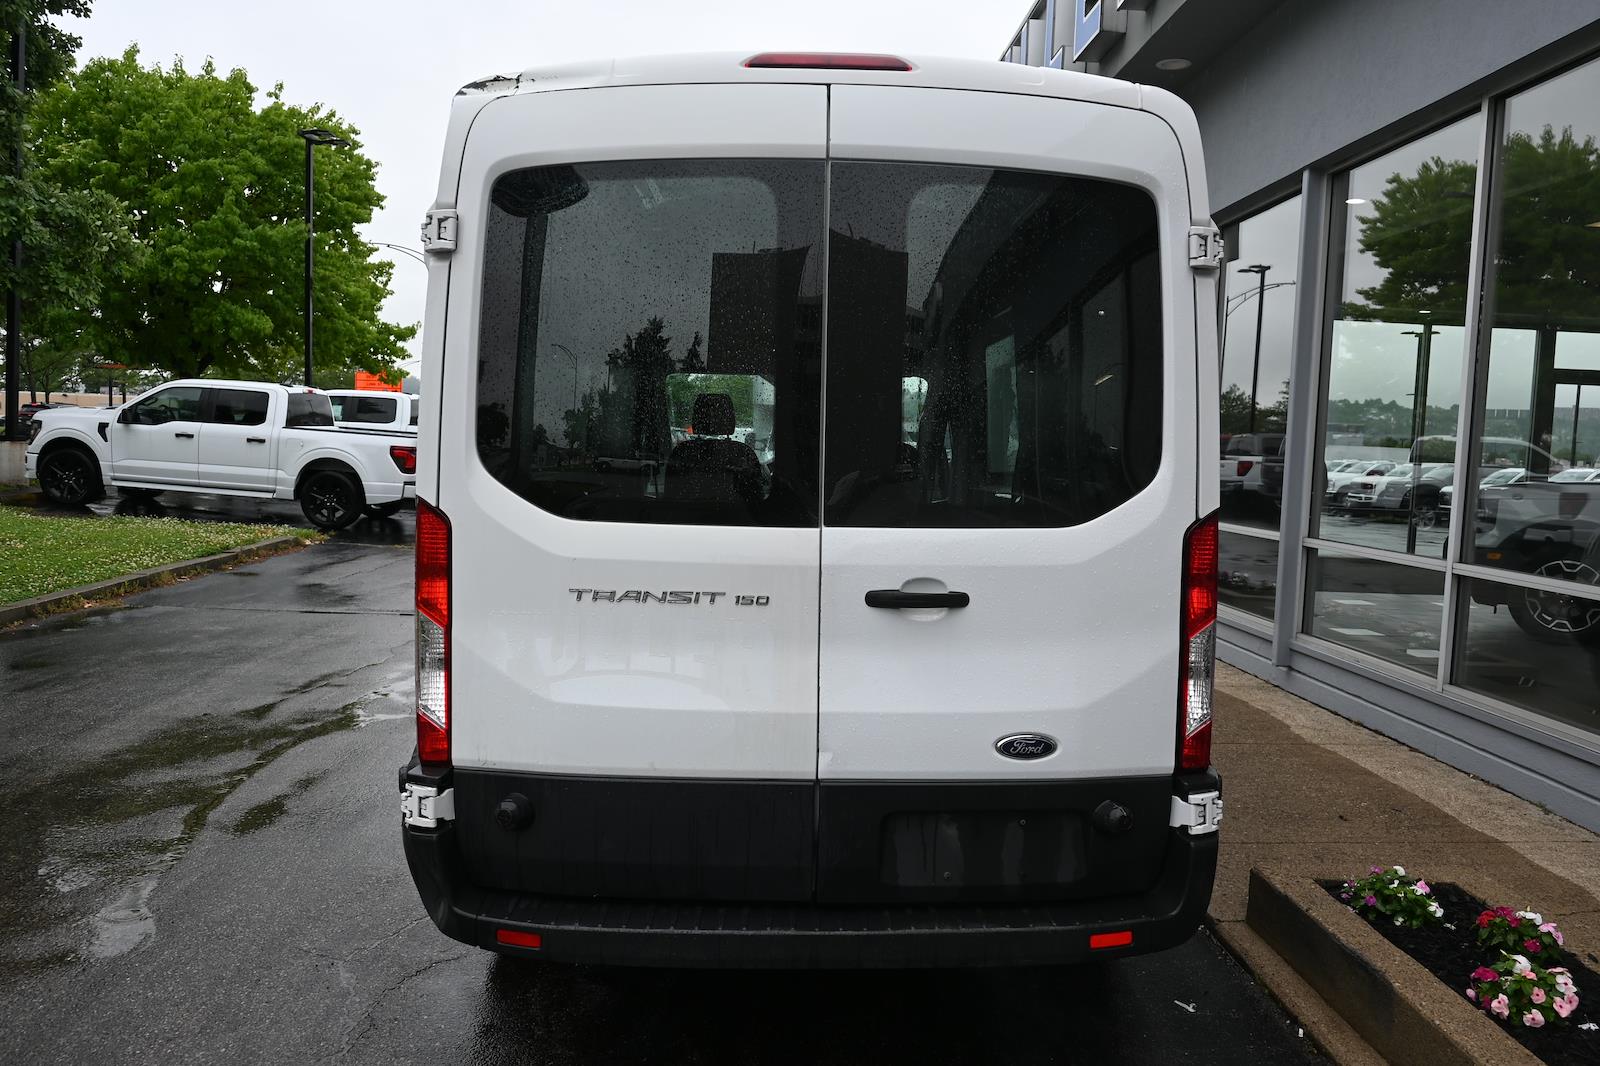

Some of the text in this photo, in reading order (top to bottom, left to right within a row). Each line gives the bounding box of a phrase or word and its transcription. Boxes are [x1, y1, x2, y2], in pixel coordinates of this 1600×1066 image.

[568, 588, 771, 607] TRANSIT 150
[1009, 739, 1045, 754] Ford
